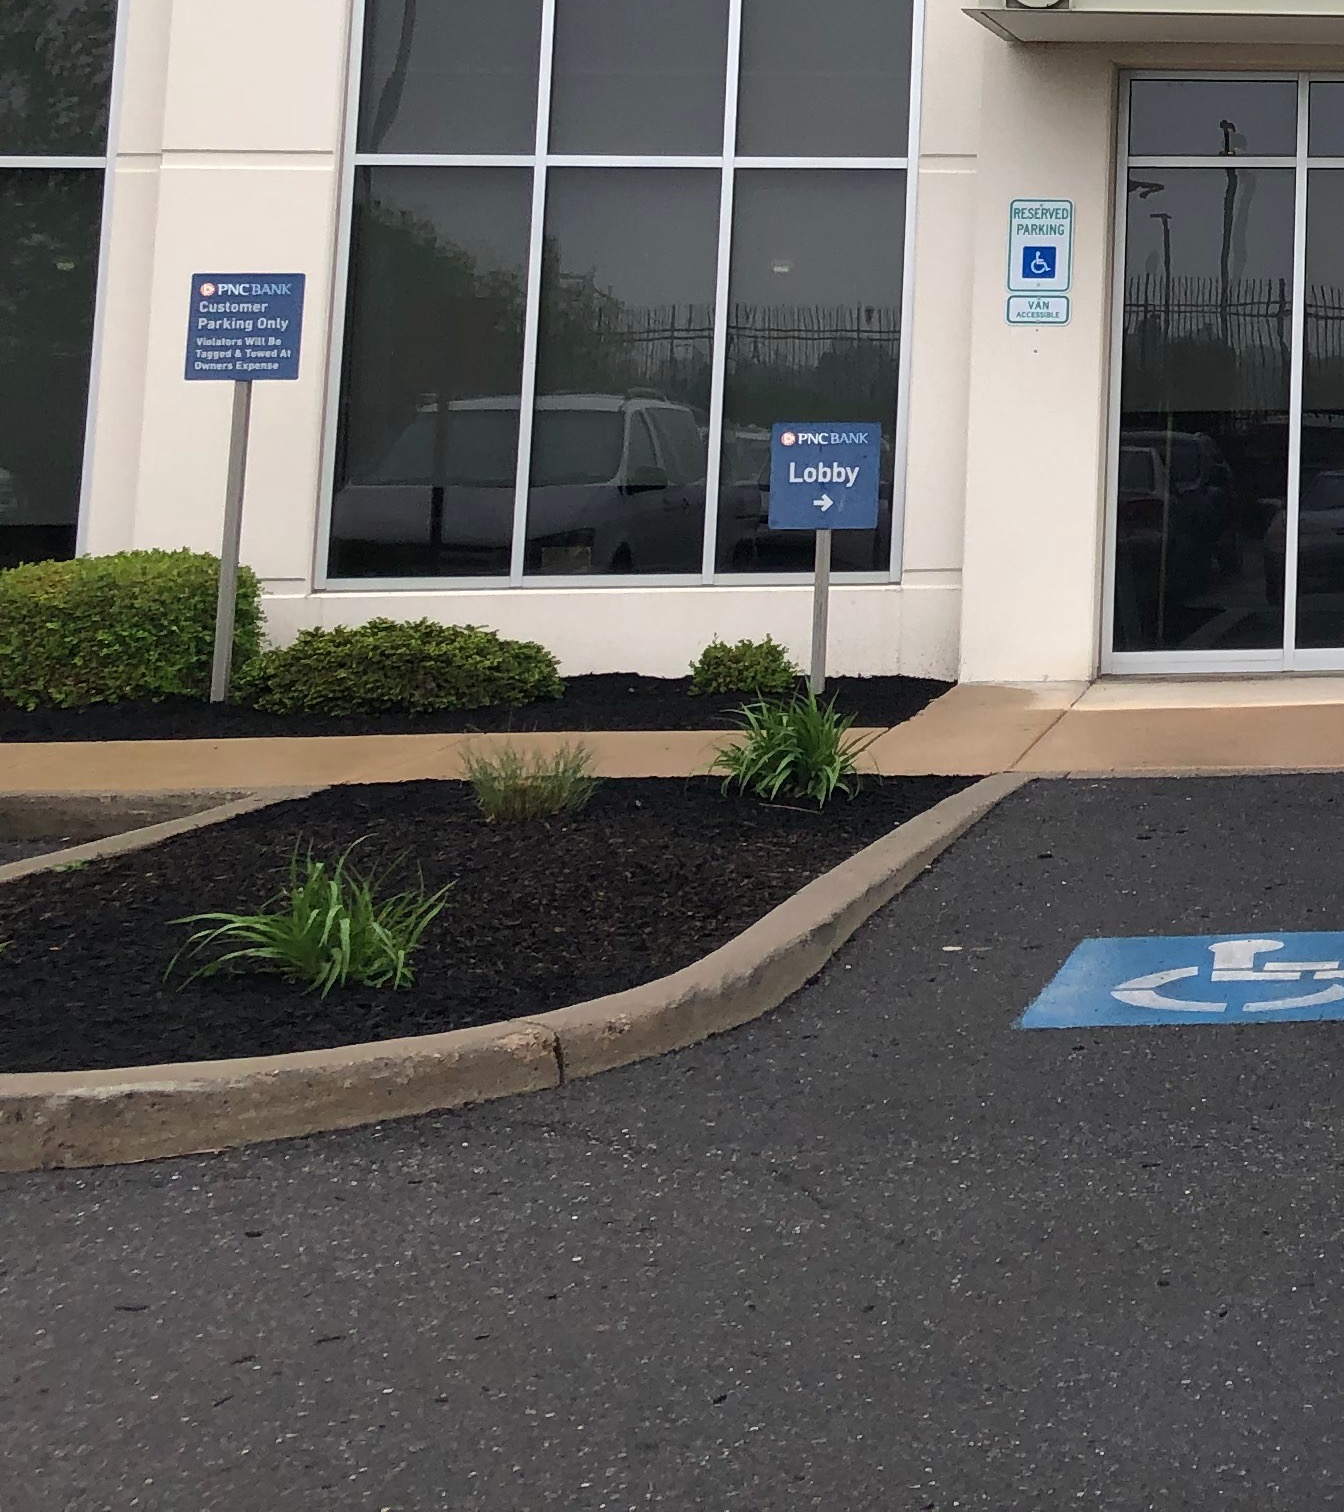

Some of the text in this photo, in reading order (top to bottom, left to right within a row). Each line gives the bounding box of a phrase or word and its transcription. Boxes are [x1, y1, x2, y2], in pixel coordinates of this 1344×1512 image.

[1013, 207, 1069, 220] RESERVED
[1016, 223, 1065, 236] PARKING
[199, 301, 268, 313] Customer
[1027, 300, 1050, 310] VAN
[1015, 310, 1060, 319] ACCESSIBLE
[197, 317, 289, 331] Parking Only
[196, 337, 243, 346] Violators
[245, 336, 266, 346] Will
[195, 349, 292, 360] Tagged & Towed At
[194, 361, 279, 372] Owners Expense
[789, 461, 860, 488] Lobby
